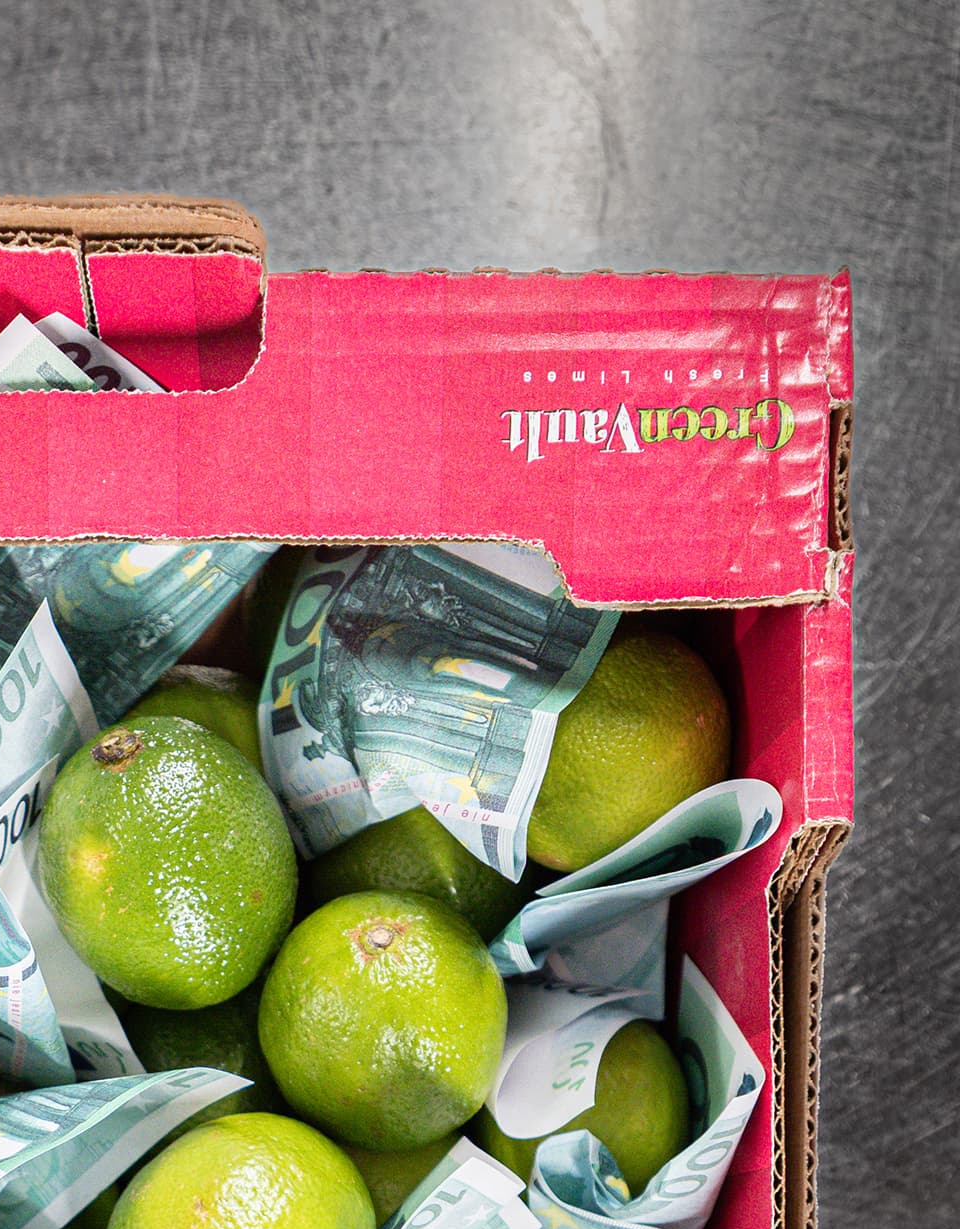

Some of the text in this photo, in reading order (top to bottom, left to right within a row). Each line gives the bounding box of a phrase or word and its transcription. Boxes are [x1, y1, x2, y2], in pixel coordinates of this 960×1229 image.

[523, 368, 769, 385] Fresh Limes
[500, 397, 797, 463] GreenVault
[272, 545, 358, 702] 10
[460, 806, 492, 823] nie
[658, 1111, 751, 1198] 100
